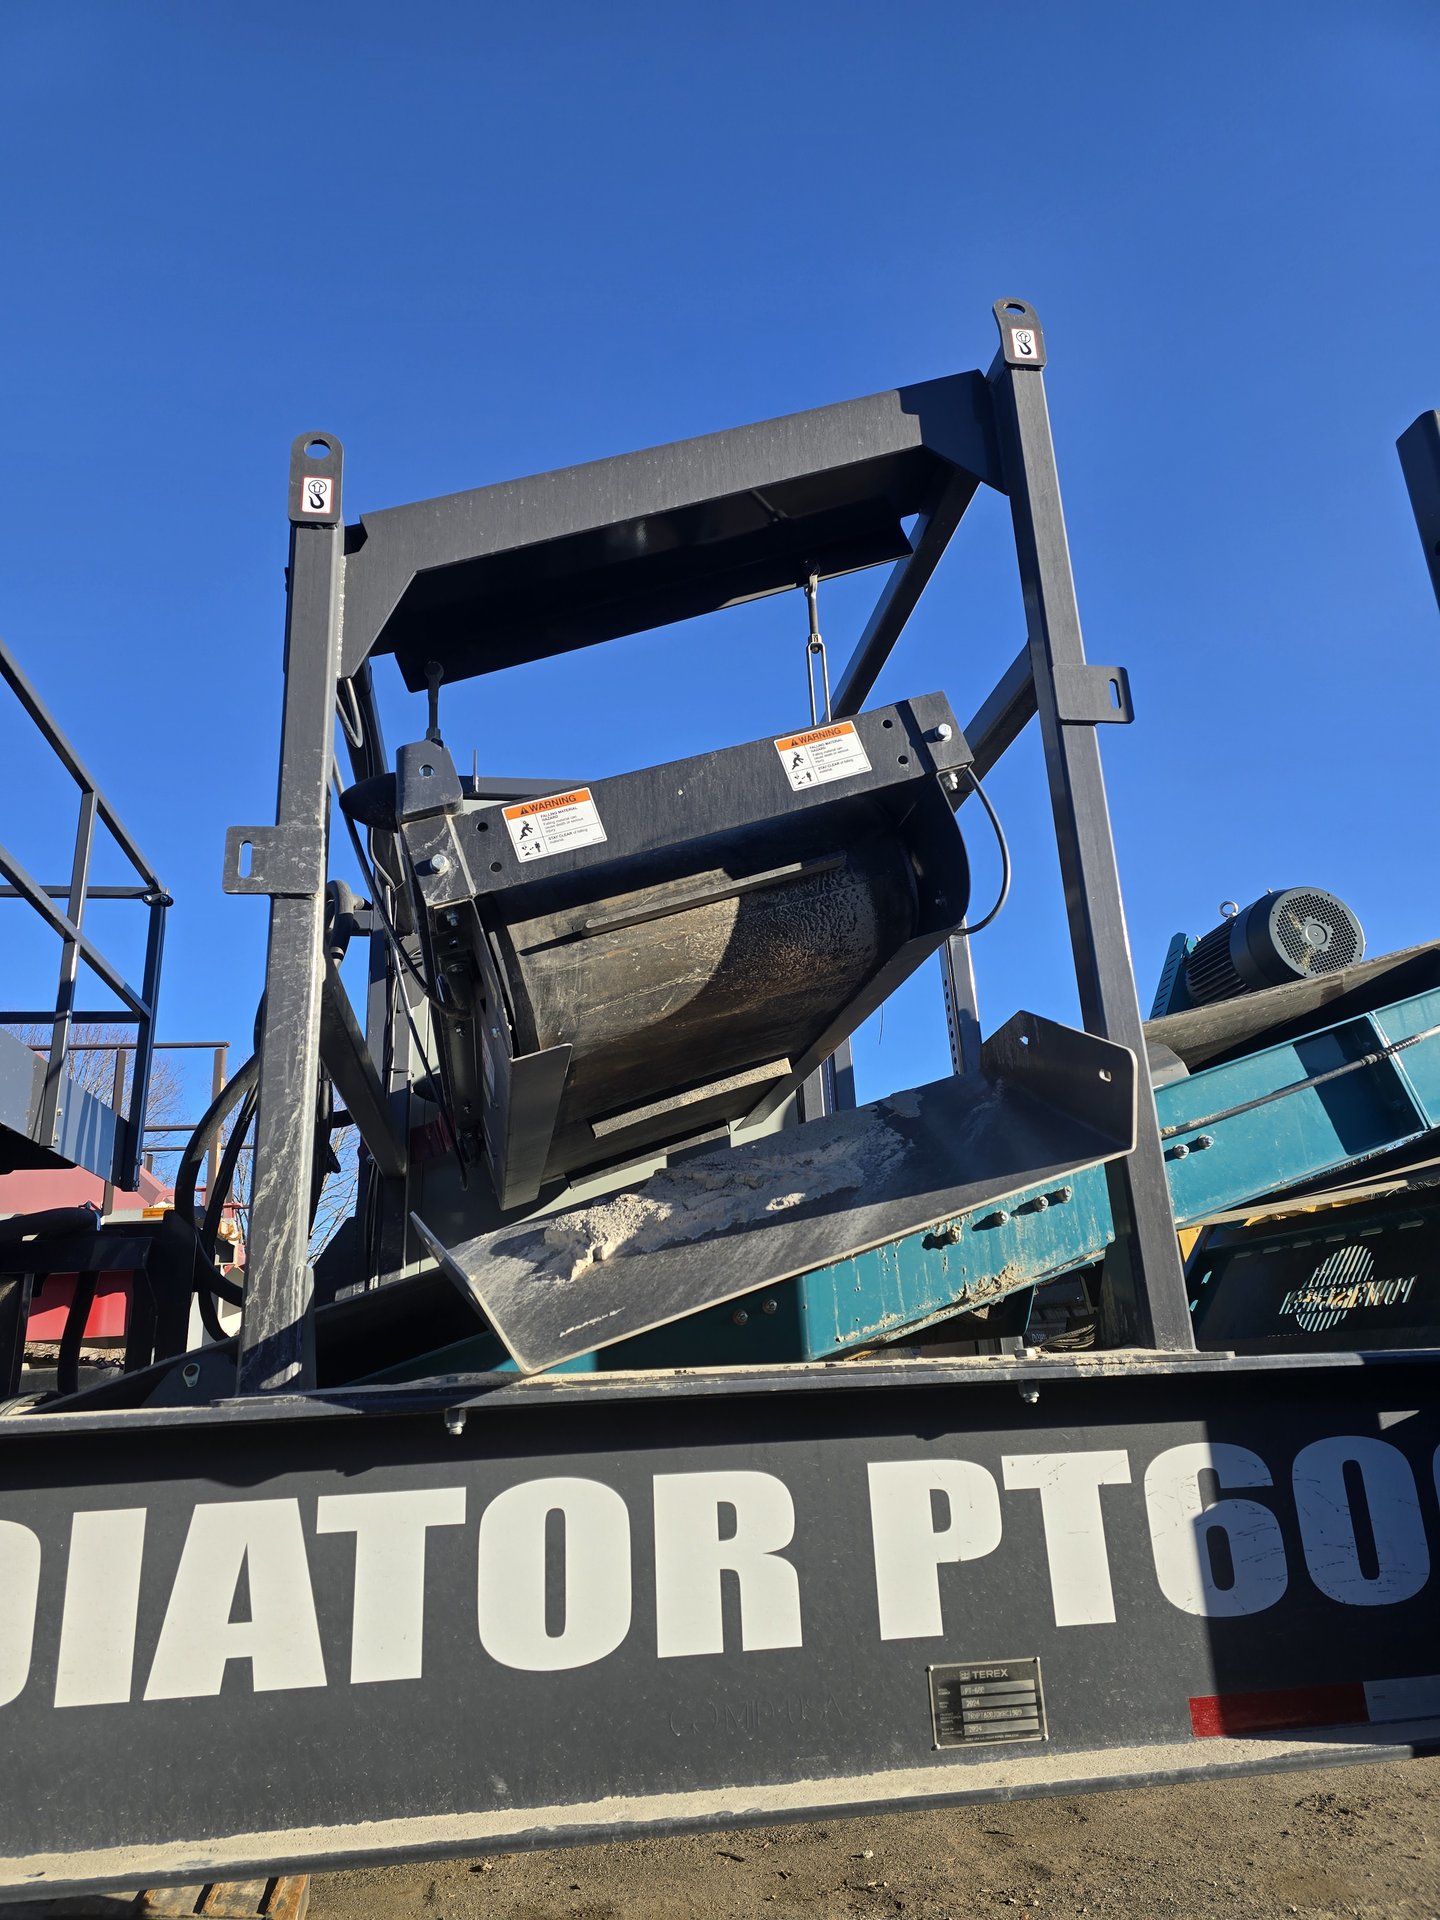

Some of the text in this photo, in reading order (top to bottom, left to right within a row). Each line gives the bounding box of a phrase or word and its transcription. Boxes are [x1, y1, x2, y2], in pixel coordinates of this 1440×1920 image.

[798, 727, 841, 743] WARNING
[529, 794, 576, 812] WARNING
[867, 1435, 1440, 1641] PT60
[972, 1668, 1008, 1680] TEREX
